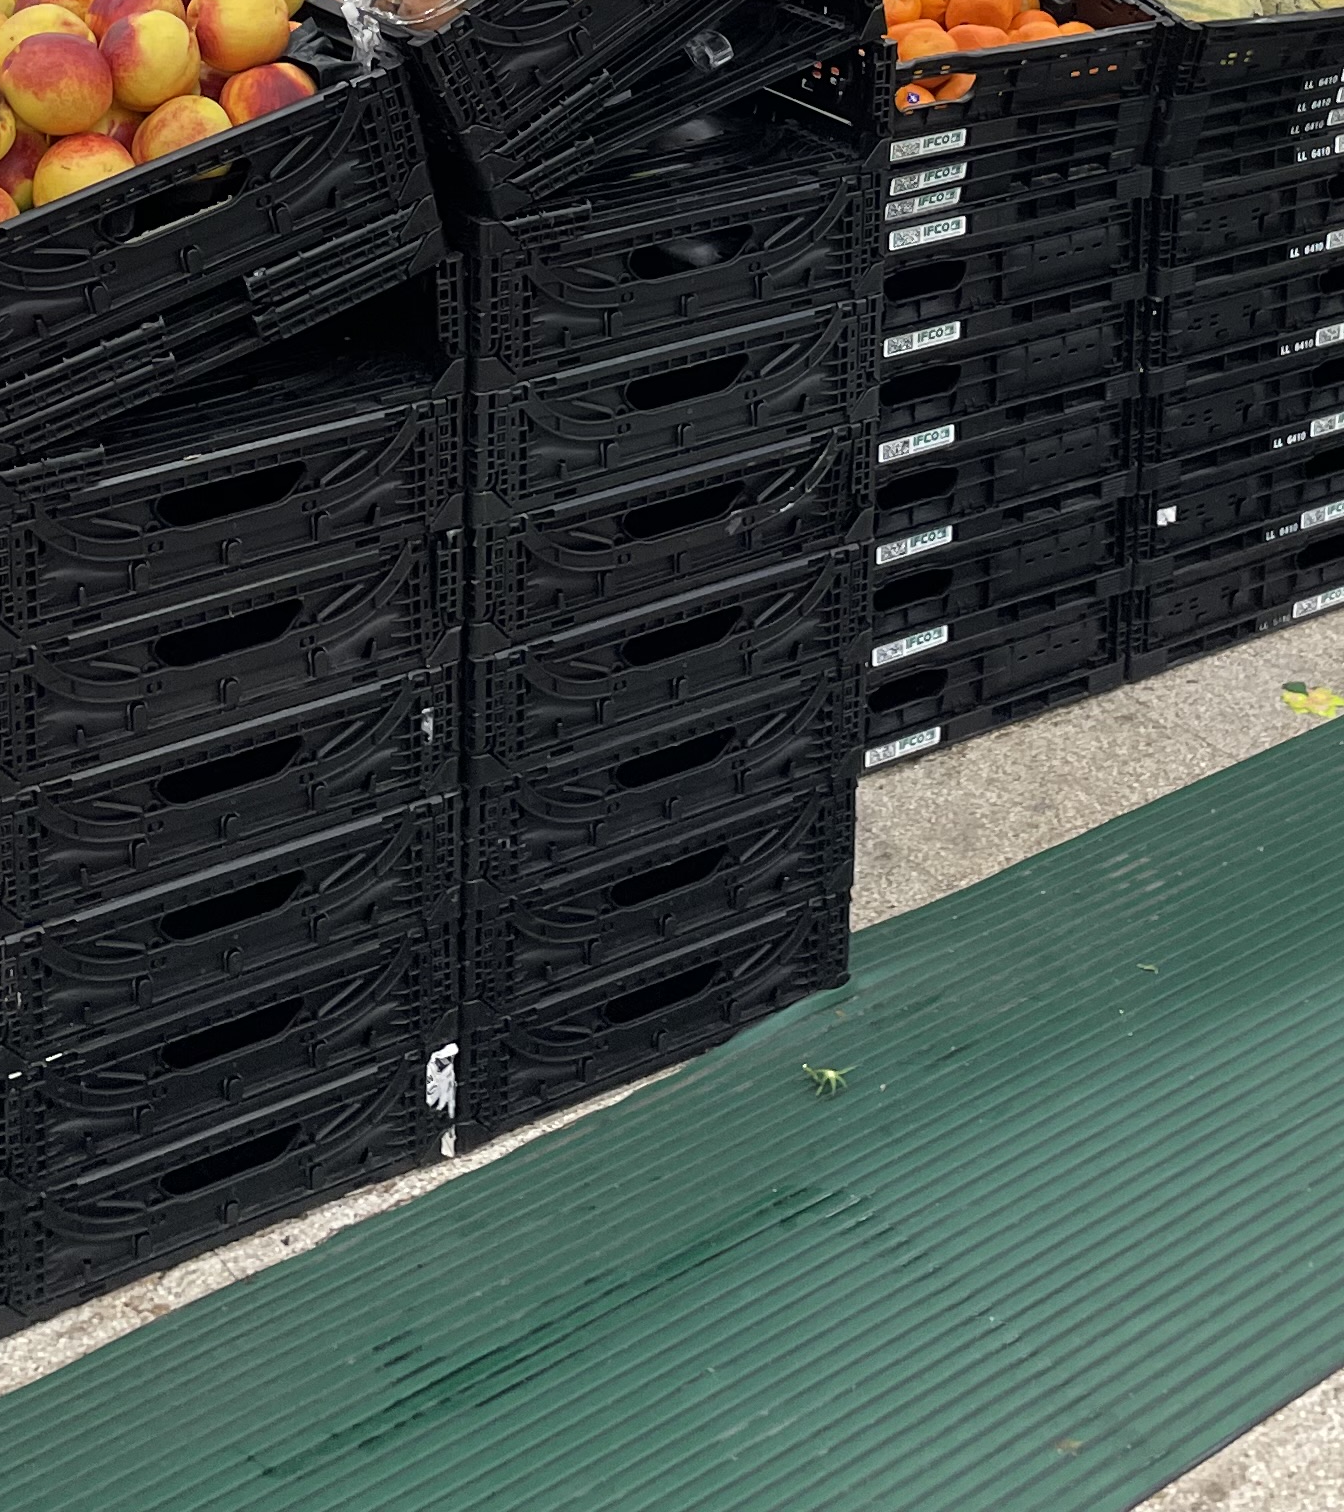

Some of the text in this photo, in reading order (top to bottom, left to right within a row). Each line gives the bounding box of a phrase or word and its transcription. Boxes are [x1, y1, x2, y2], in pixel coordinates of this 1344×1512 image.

[923, 134, 950, 148] IFCO
[924, 167, 950, 182] IFCO
[918, 192, 945, 207] IFCO
[923, 222, 950, 237] IFCO
[917, 327, 944, 343] IFCO
[912, 430, 939, 446] IFCO
[910, 531, 936, 548] IFCO
[905, 633, 932, 649] IFCO
[898, 733, 925, 750] IFCO
